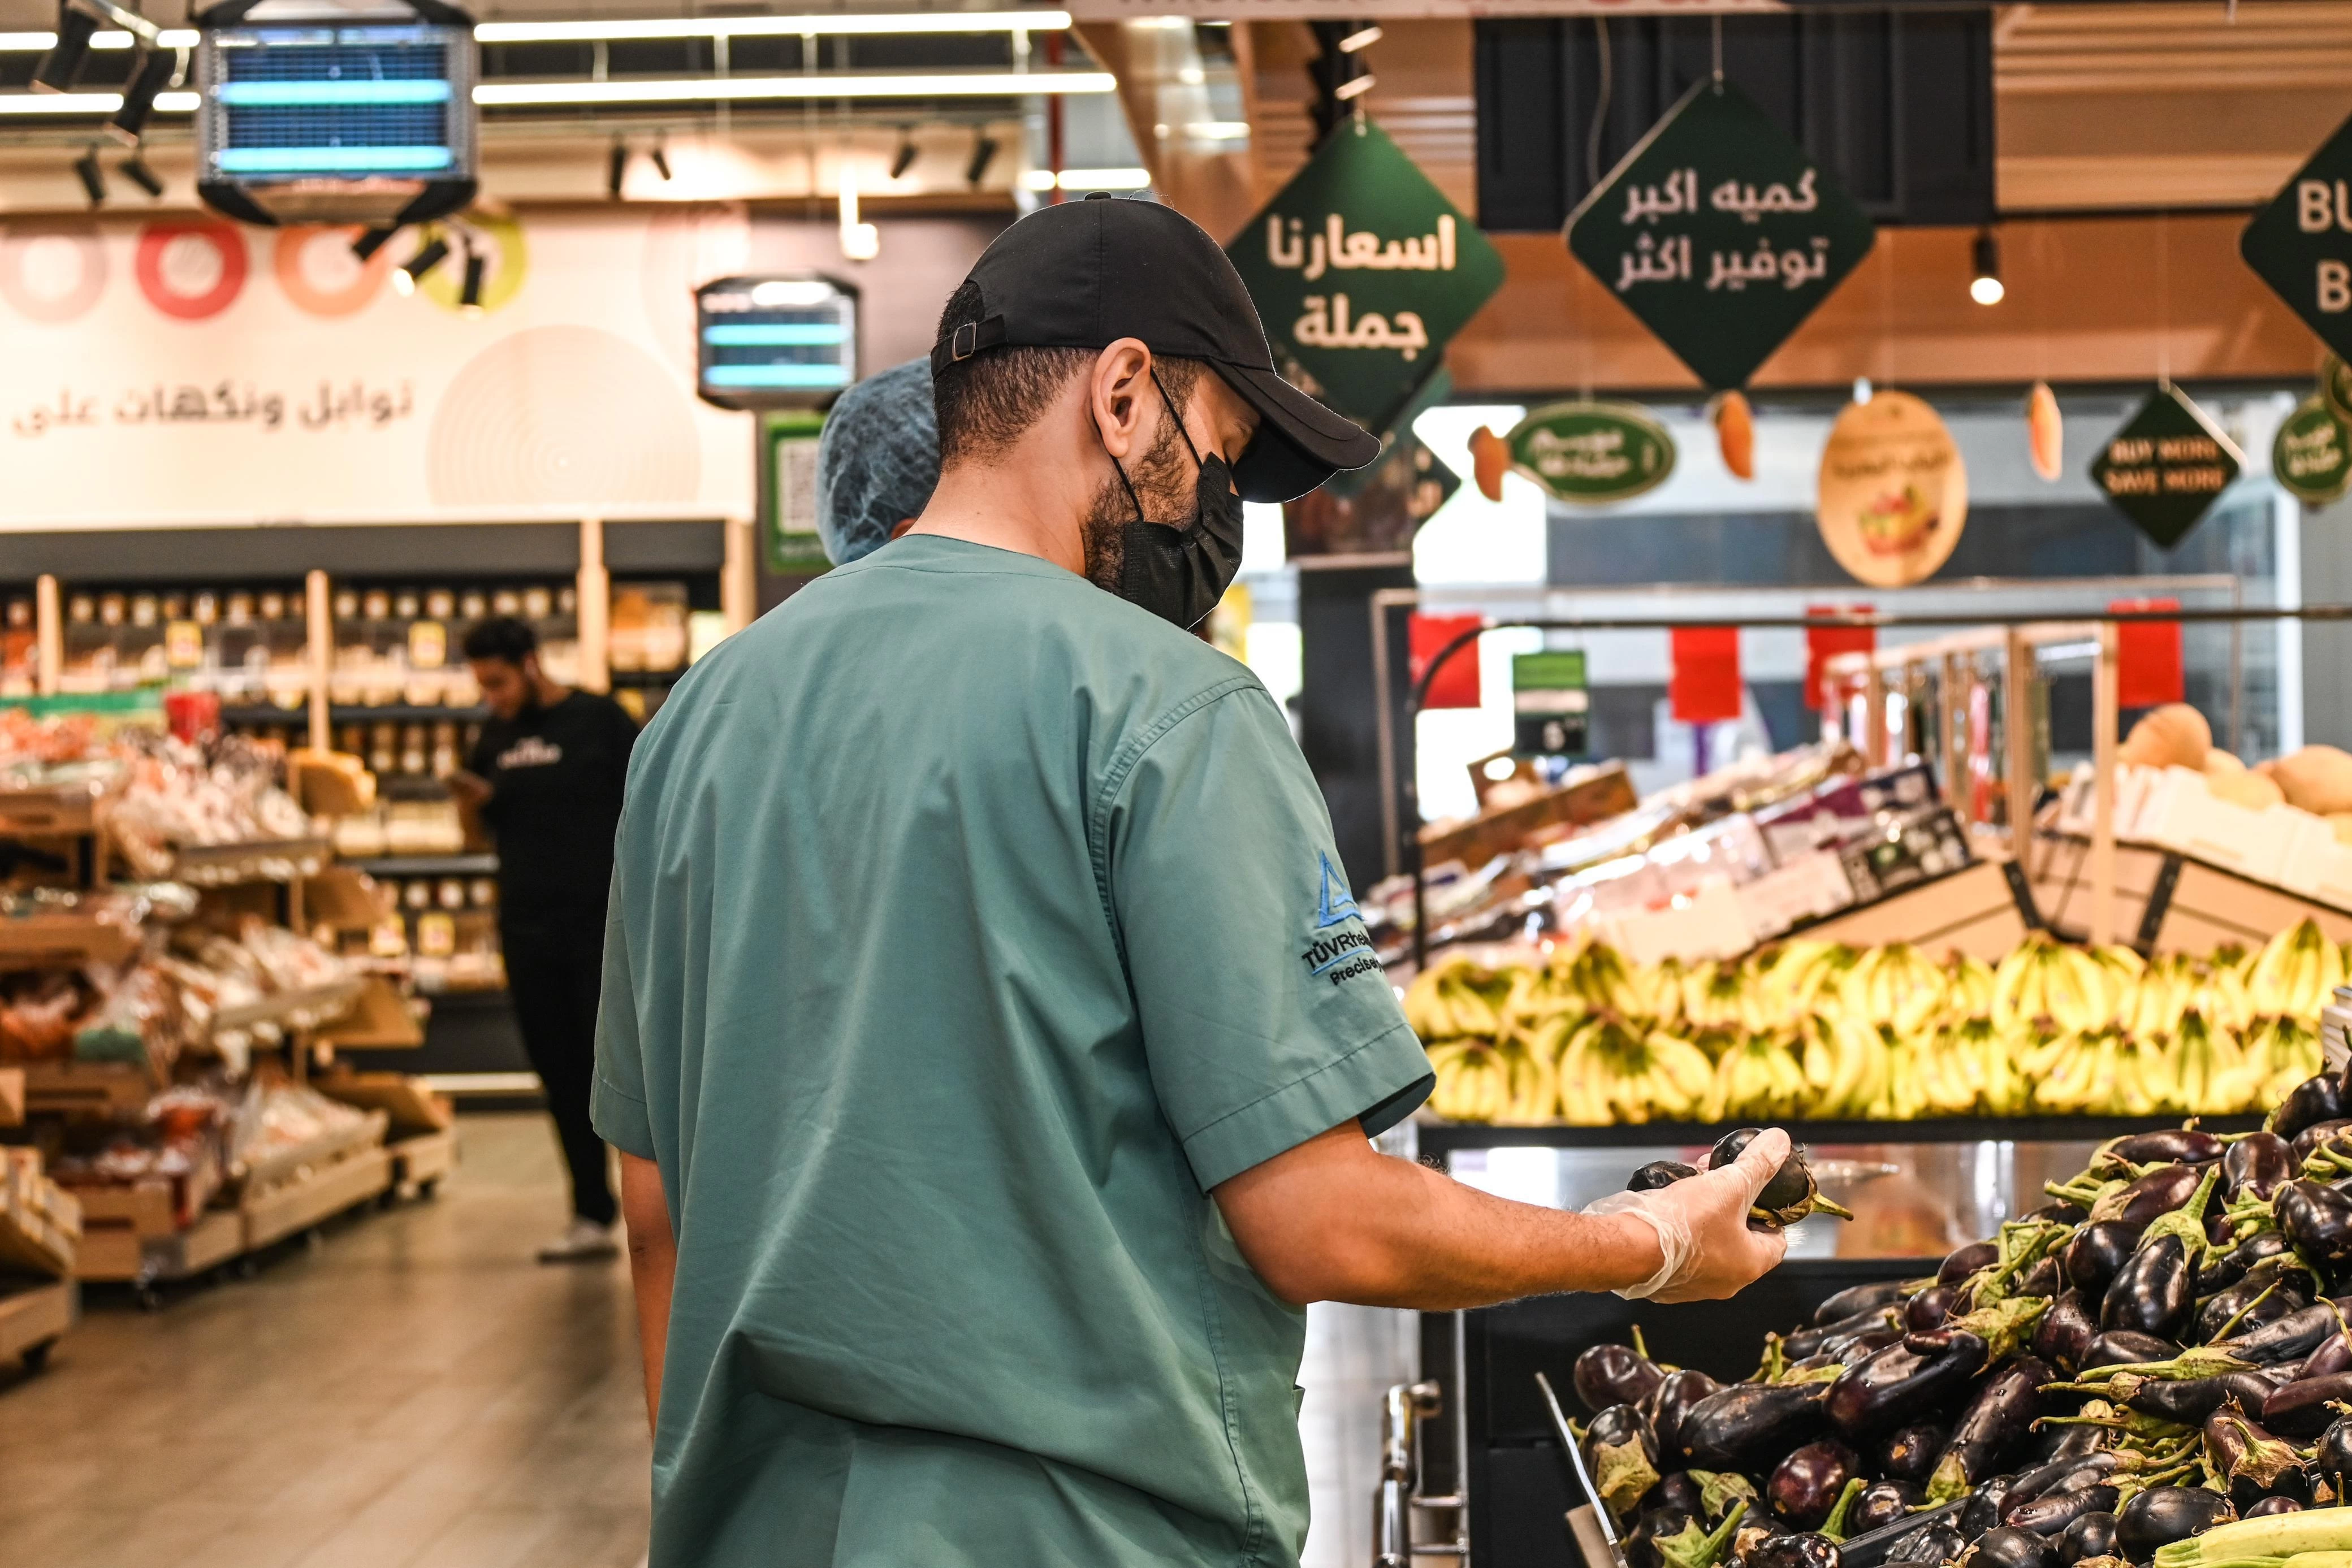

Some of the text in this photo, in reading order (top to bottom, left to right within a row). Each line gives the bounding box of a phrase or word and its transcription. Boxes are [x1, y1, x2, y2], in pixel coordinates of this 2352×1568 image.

[1622, 168, 1819, 225] كميه اكبر
[1267, 214, 1456, 281] اسعارنا
[1705, 236, 1831, 291] توفير
[1292, 293, 1429, 362] جملة
